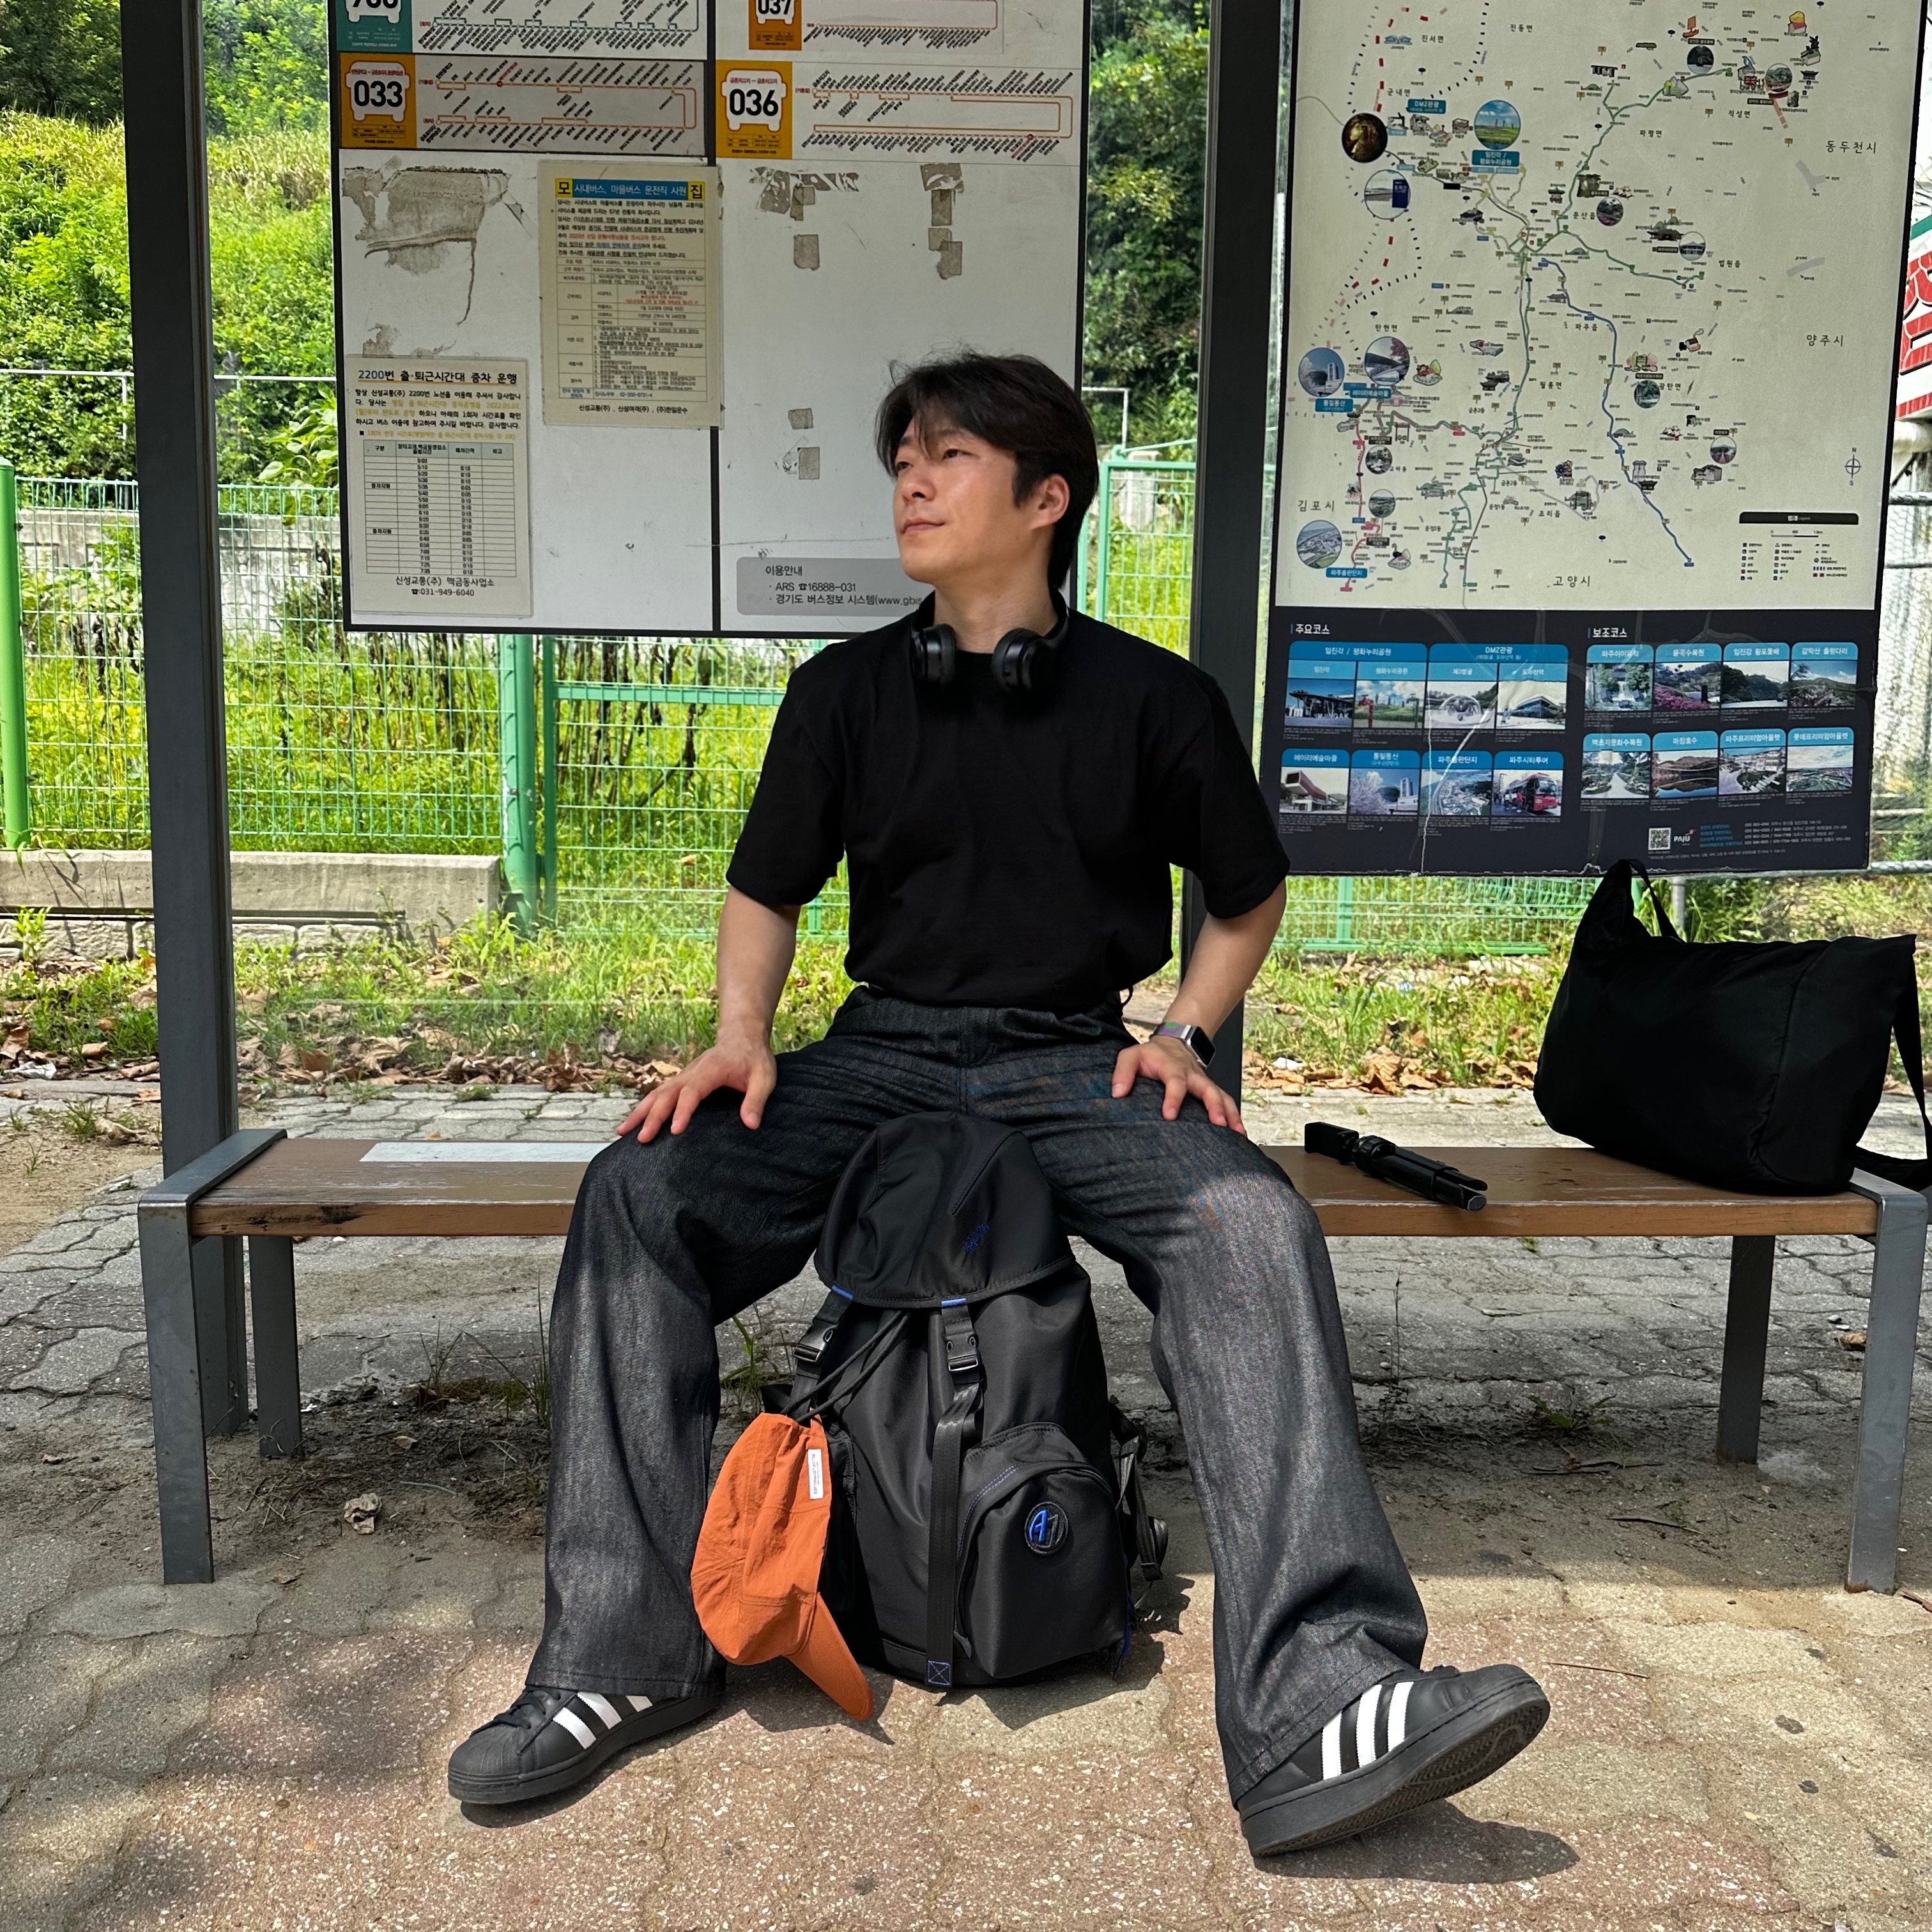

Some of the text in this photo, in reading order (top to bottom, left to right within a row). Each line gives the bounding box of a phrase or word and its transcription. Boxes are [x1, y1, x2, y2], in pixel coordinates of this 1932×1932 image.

[354, 80, 402, 107] 033
[1388, 88, 1410, 96] 군내면
[730, 89, 778, 116] 036
[1728, 110, 1750, 118] 적성면
[1826, 141, 1876, 153] 동두천시
[558, 182, 571, 194] 모
[611, 185, 641, 194] 마을버스
[645, 185, 667, 195] 운전직
[671, 187, 686, 195] 사원
[691, 185, 702, 199] 집
[1573, 211, 1597, 220] 문산읍
[1807, 335, 1843, 346] 양주시
[359, 371, 394, 381] 2200번
[471, 372, 491, 383] 증차
[497, 373, 516, 384] 운행
[1298, 500, 1334, 512] 김포시
[766, 565, 802, 576] 이용안내
[396, 576, 494, 587] 신성교통(주) 맥금동사업소
[776, 582, 794, 591] ARS
[1553, 576, 1590, 588] 고양시
[776, 594, 803, 604] 경기도
[808, 595, 843, 604] 버스정보
[1296, 624, 1330, 634] 주요코스
[1593, 628, 1627, 637] 보조코스
[1485, 647, 1513, 656] DMZ관광
[1374, 753, 1399, 762] 통일동산
[1674, 834, 1690, 843] PAJU
